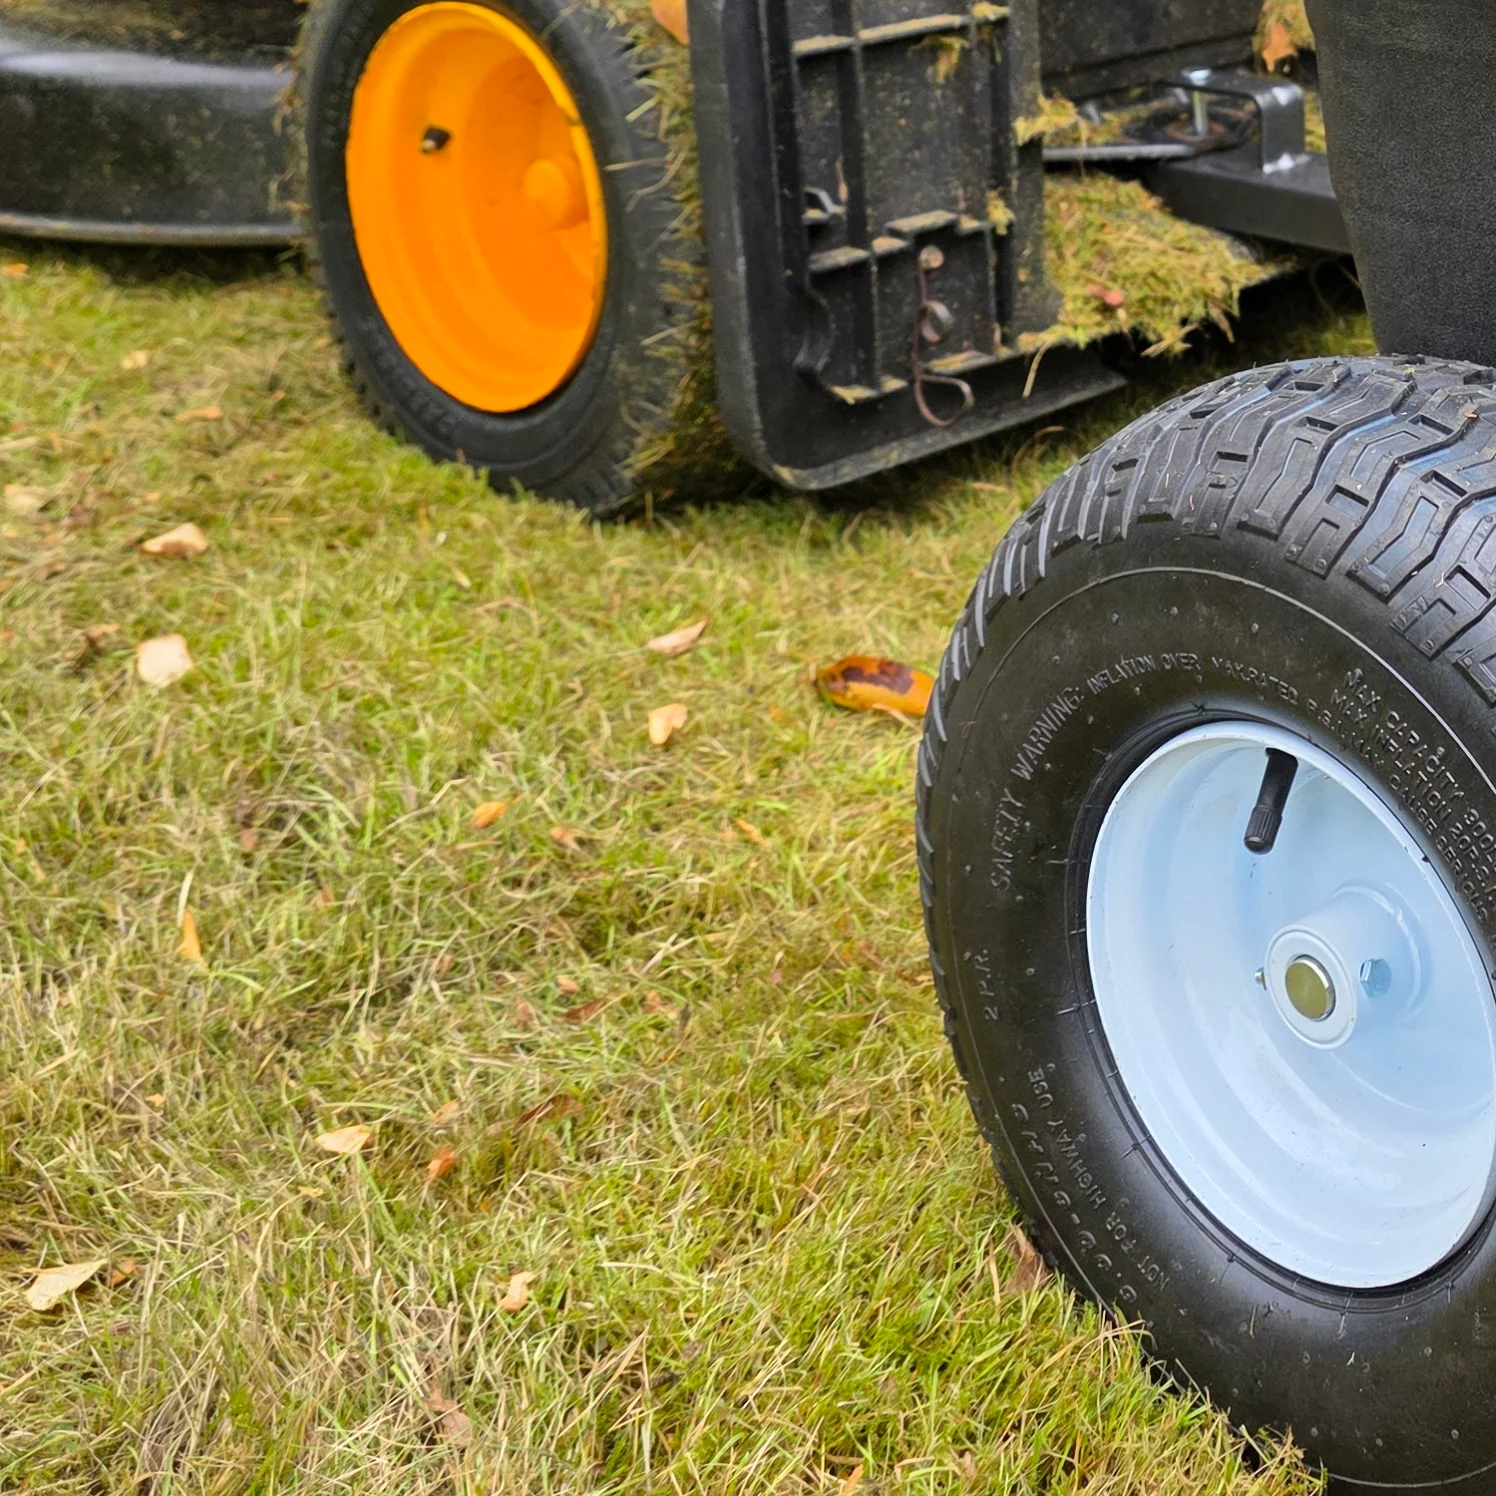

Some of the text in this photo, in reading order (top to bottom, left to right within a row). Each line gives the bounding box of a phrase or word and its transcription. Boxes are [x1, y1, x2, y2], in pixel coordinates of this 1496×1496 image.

[990, 784, 1026, 894] SAFETY
[1010, 678, 1085, 785] WARNING:
[1086, 650, 1158, 695] INFLATION
[1158, 651, 1202, 670] OVER
[1387, 770, 1438, 836] CAUSE
[1433, 832, 1491, 924] SERIOUS
[1370, 721, 1452, 824] INFLATION
[1384, 706, 1465, 807] CAPACITY
[1026, 1067, 1170, 1296] NOT FOR HIGHWAY USE
